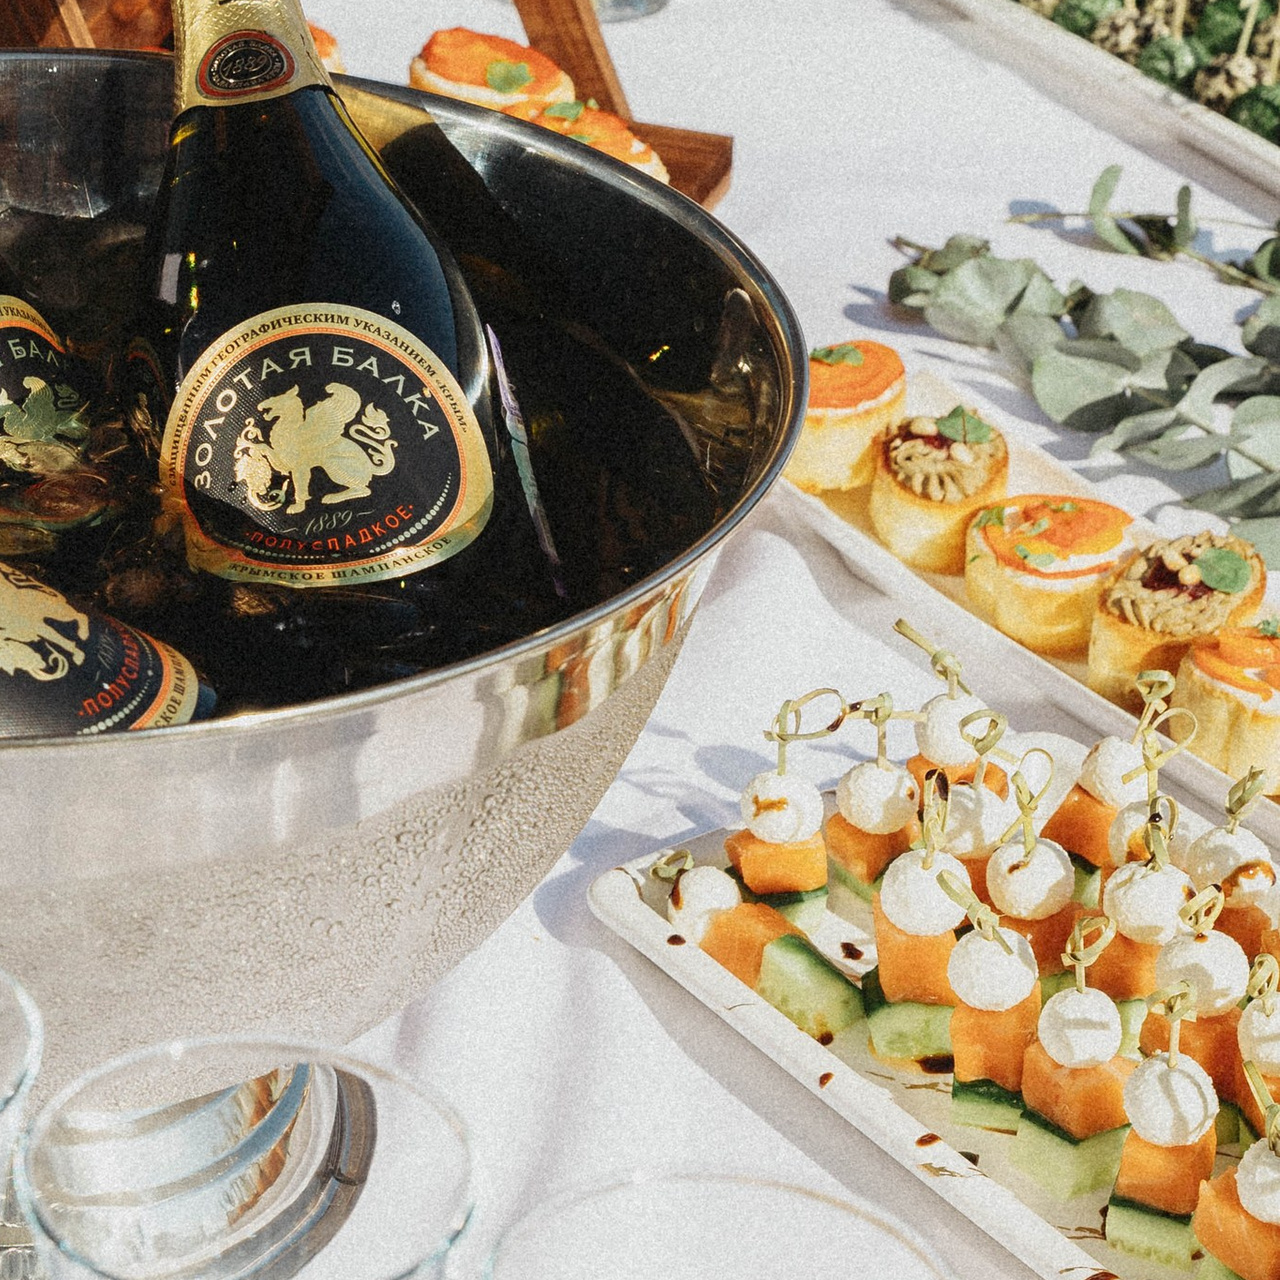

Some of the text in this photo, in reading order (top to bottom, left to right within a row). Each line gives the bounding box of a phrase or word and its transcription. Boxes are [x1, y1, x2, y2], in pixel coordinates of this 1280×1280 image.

[222, 55, 268, 77] 1889
[7, 338, 59, 368] БАЛ
[168, 368, 212, 479] ЗАЩИЩЕННЫМ
[212, 313, 350, 367] ГЕОГРАФИЧЕСКИМ
[353, 318, 437, 378] УКАЗАНИЕМ
[194, 346, 440, 490] ЗОЛОТАЯ БАЛКА
[250, 504, 413, 552] ПОЛУСЛАДКОЕ
[304, 510, 353, 536] 1889
[330, 536, 453, 579] ШАМПАНСКОЕ
[154, 695, 182, 728] СКОЕ
